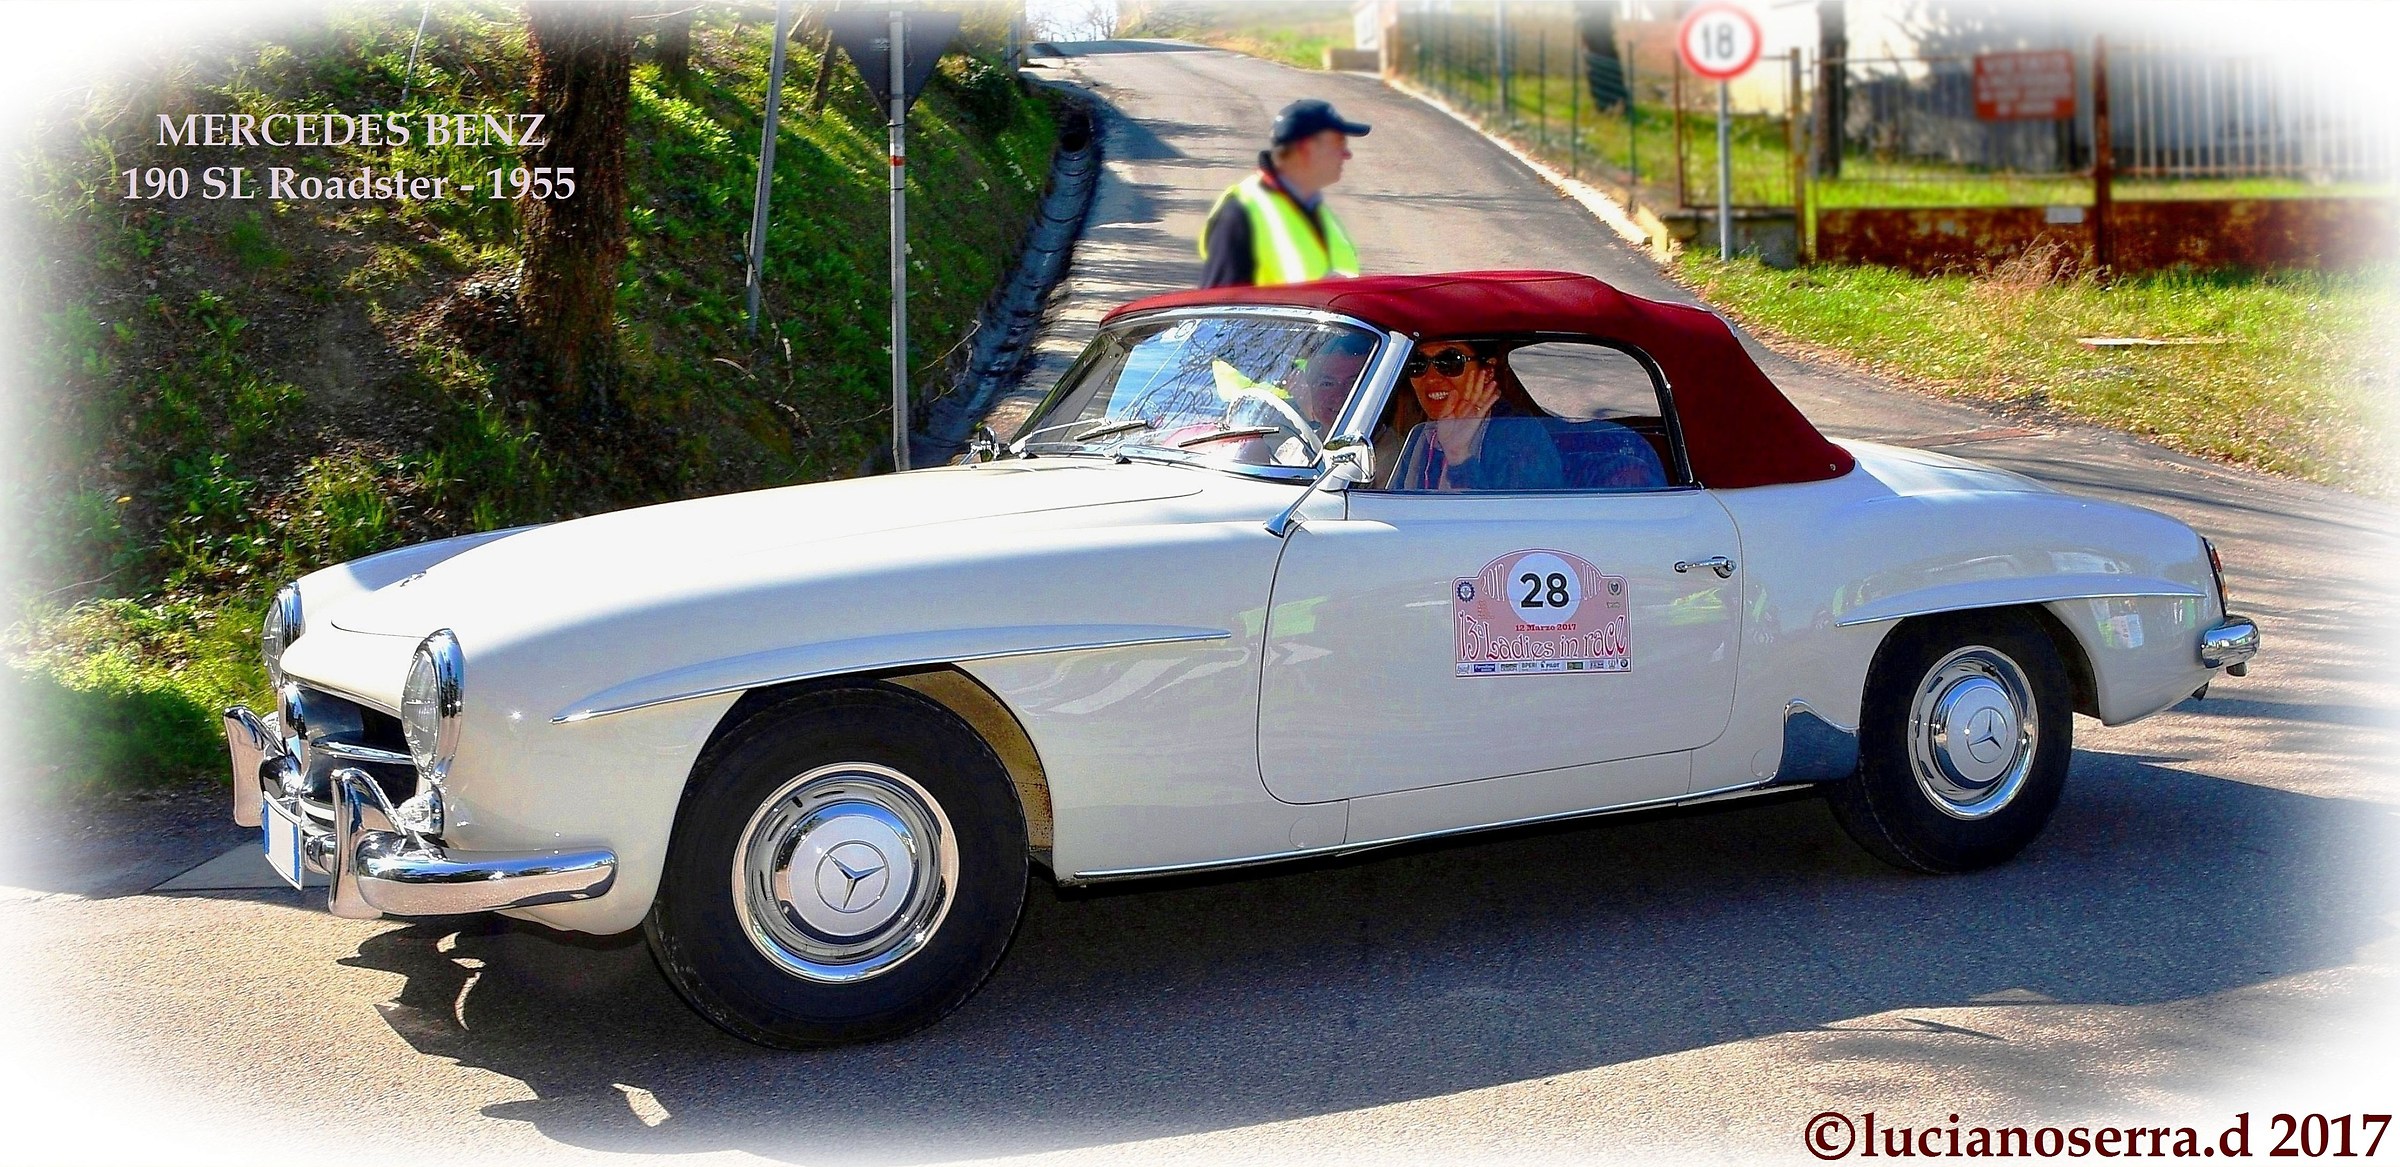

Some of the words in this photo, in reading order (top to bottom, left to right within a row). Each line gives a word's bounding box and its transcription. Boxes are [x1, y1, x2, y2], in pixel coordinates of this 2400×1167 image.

[1703, 22, 1735, 60] 18
[1518, 572, 1571, 609] 28
[1483, 621, 1556, 663] Ladies
[1560, 634, 1580, 660] in
[1582, 614, 1627, 665] race
[1515, 624, 1525, 632] 12
[1526, 623, 1556, 632] Marzo
[1557, 623, 1577, 631] 2017
